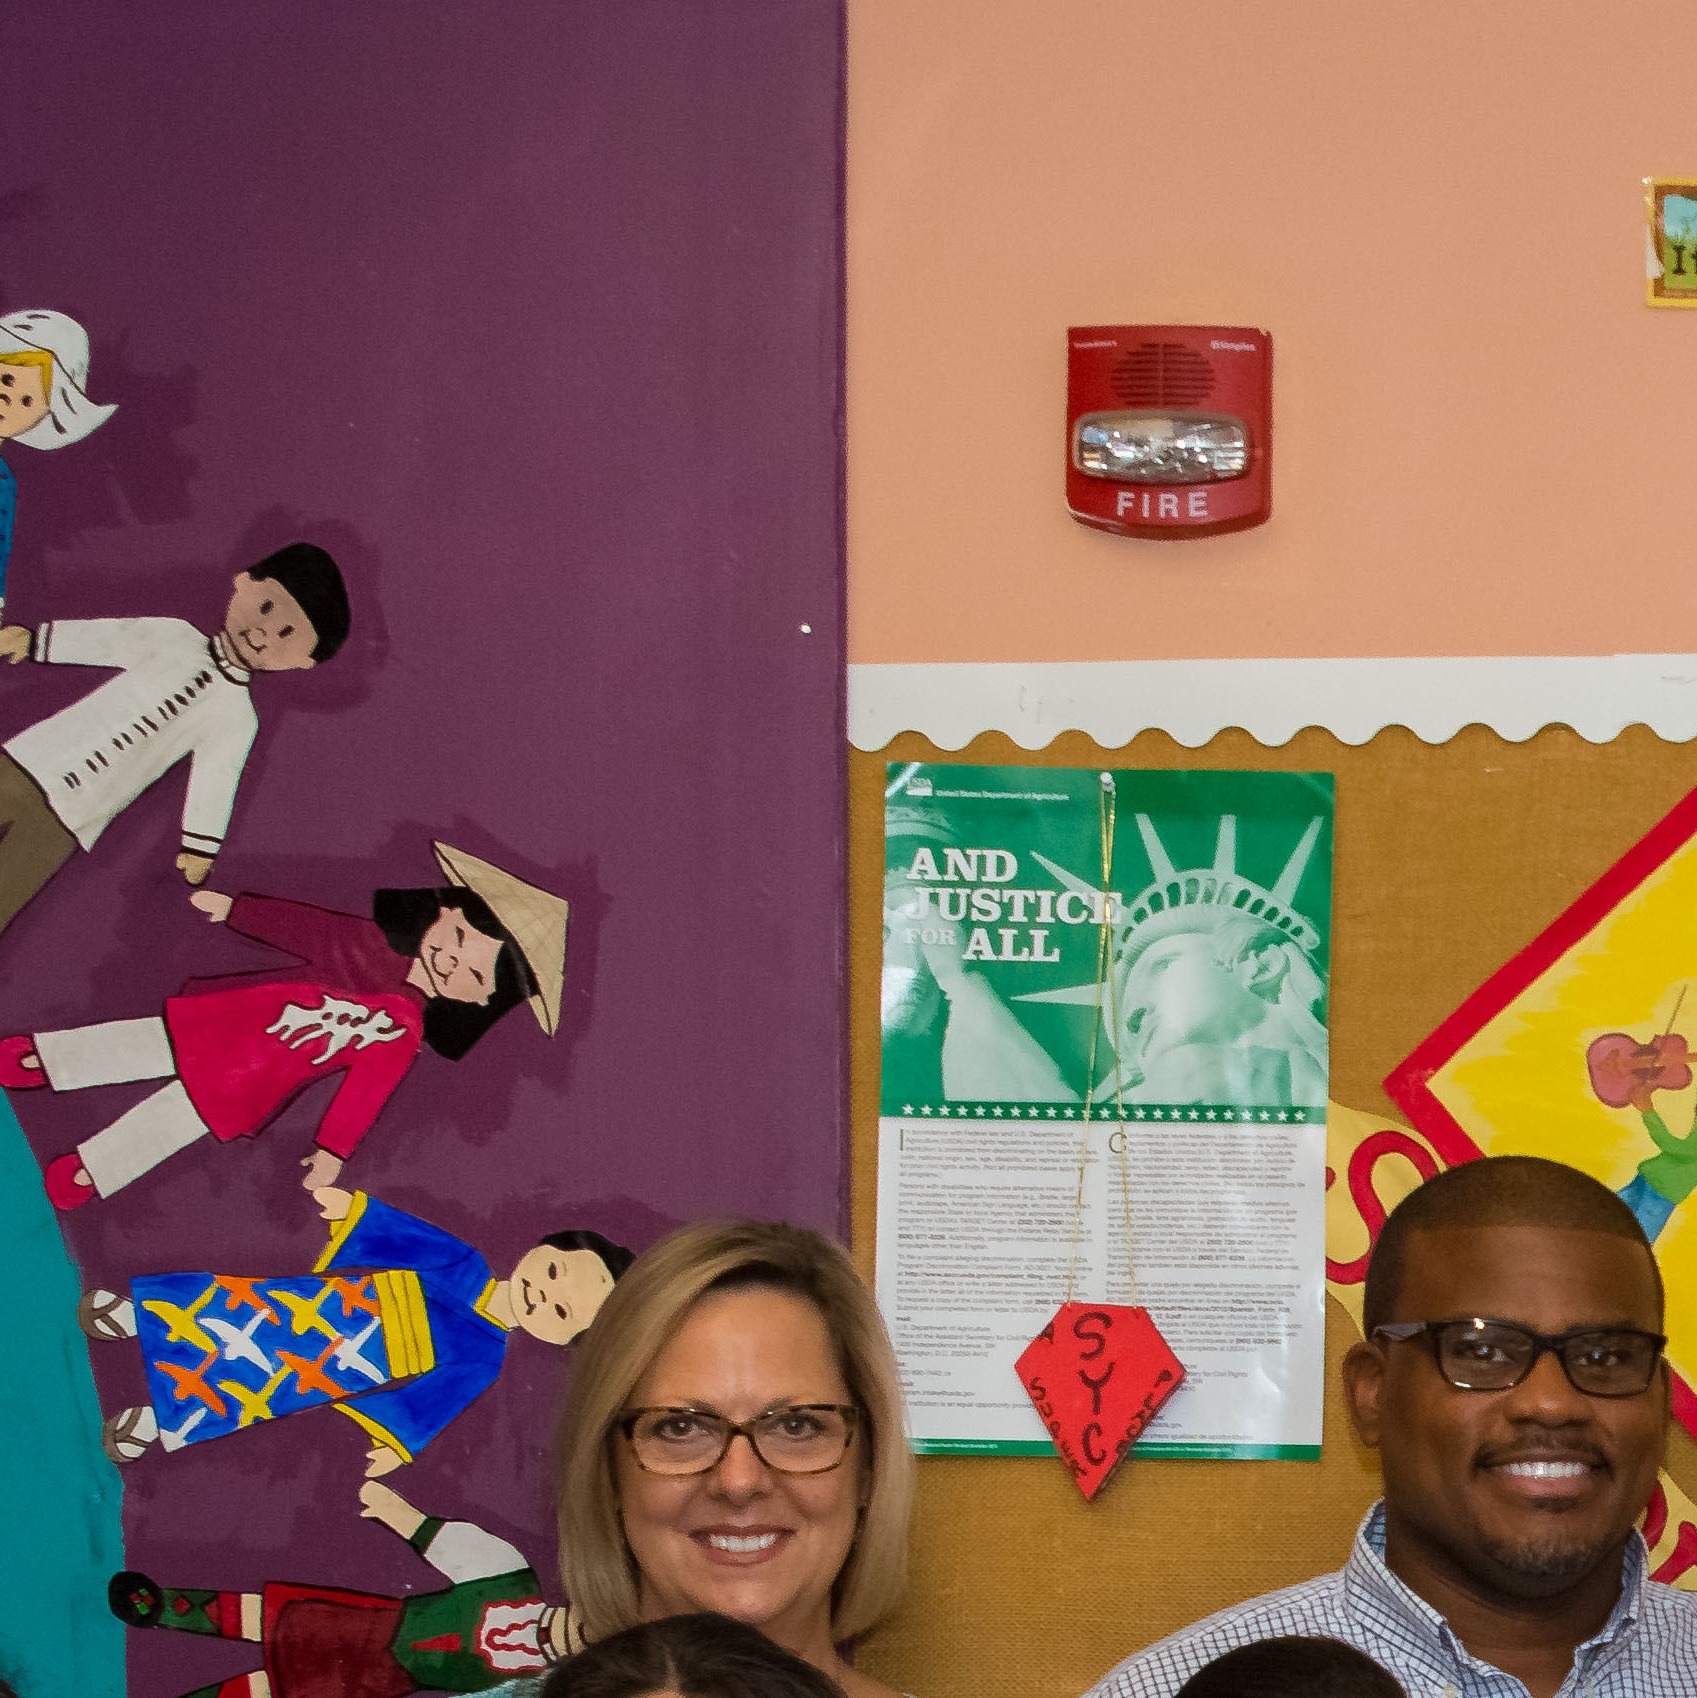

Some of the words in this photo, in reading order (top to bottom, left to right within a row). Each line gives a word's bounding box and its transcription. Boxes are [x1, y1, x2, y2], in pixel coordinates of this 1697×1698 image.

[1117, 490, 1208, 519] FIRE
[907, 847, 1018, 883] AND
[906, 886, 1122, 925] JUSTICE
[906, 927, 956, 945] FOR
[962, 927, 1061, 962] ALL
